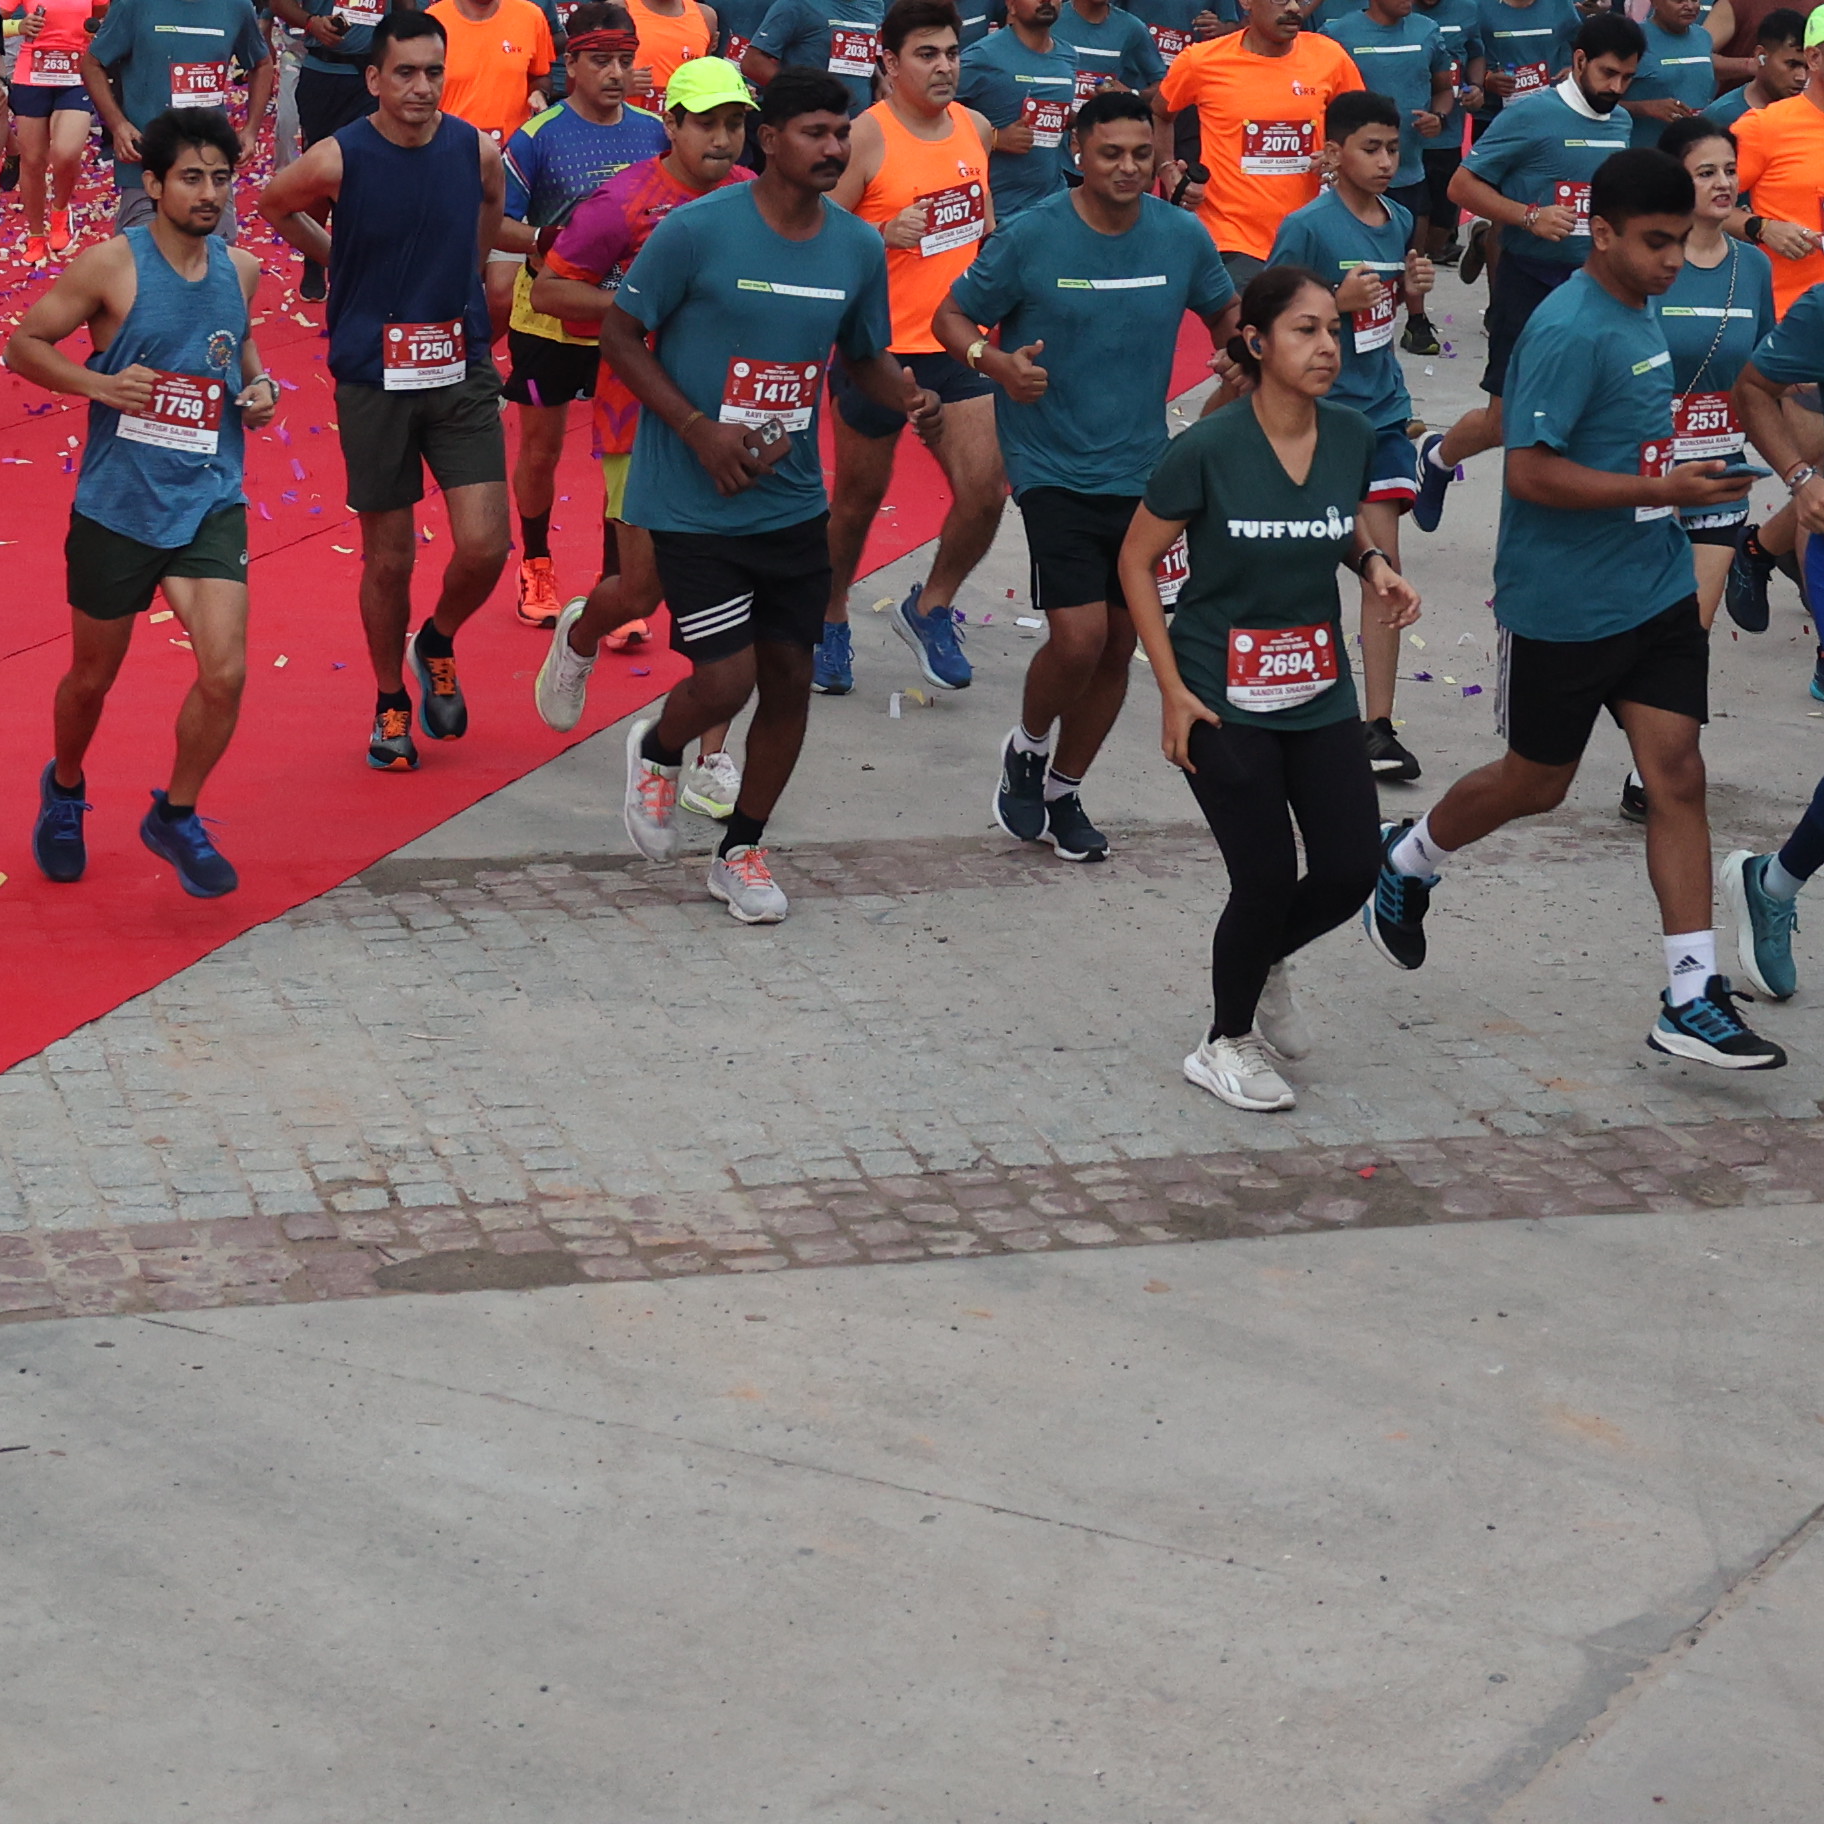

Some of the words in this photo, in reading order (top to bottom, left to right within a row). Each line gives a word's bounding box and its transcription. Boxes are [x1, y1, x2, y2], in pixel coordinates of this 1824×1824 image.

[844, 43, 869, 58] 2038
[1158, 37, 1184, 52] 1634
[43, 58, 70, 71] 2639
[187, 74, 217, 89] 1162
[1514, 73, 1540, 89] 2035
[1035, 113, 1063, 130] 2039
[1261, 135, 1301, 152] 2070
[933, 200, 972, 225] 2057
[1574, 198, 1591, 214] 16
[407, 340, 453, 361] 1250
[753, 380, 802, 404] 1412
[153, 393, 205, 421] 1759
[1686, 408, 1729, 431] 2531
[1258, 651, 1315, 677] 2694
